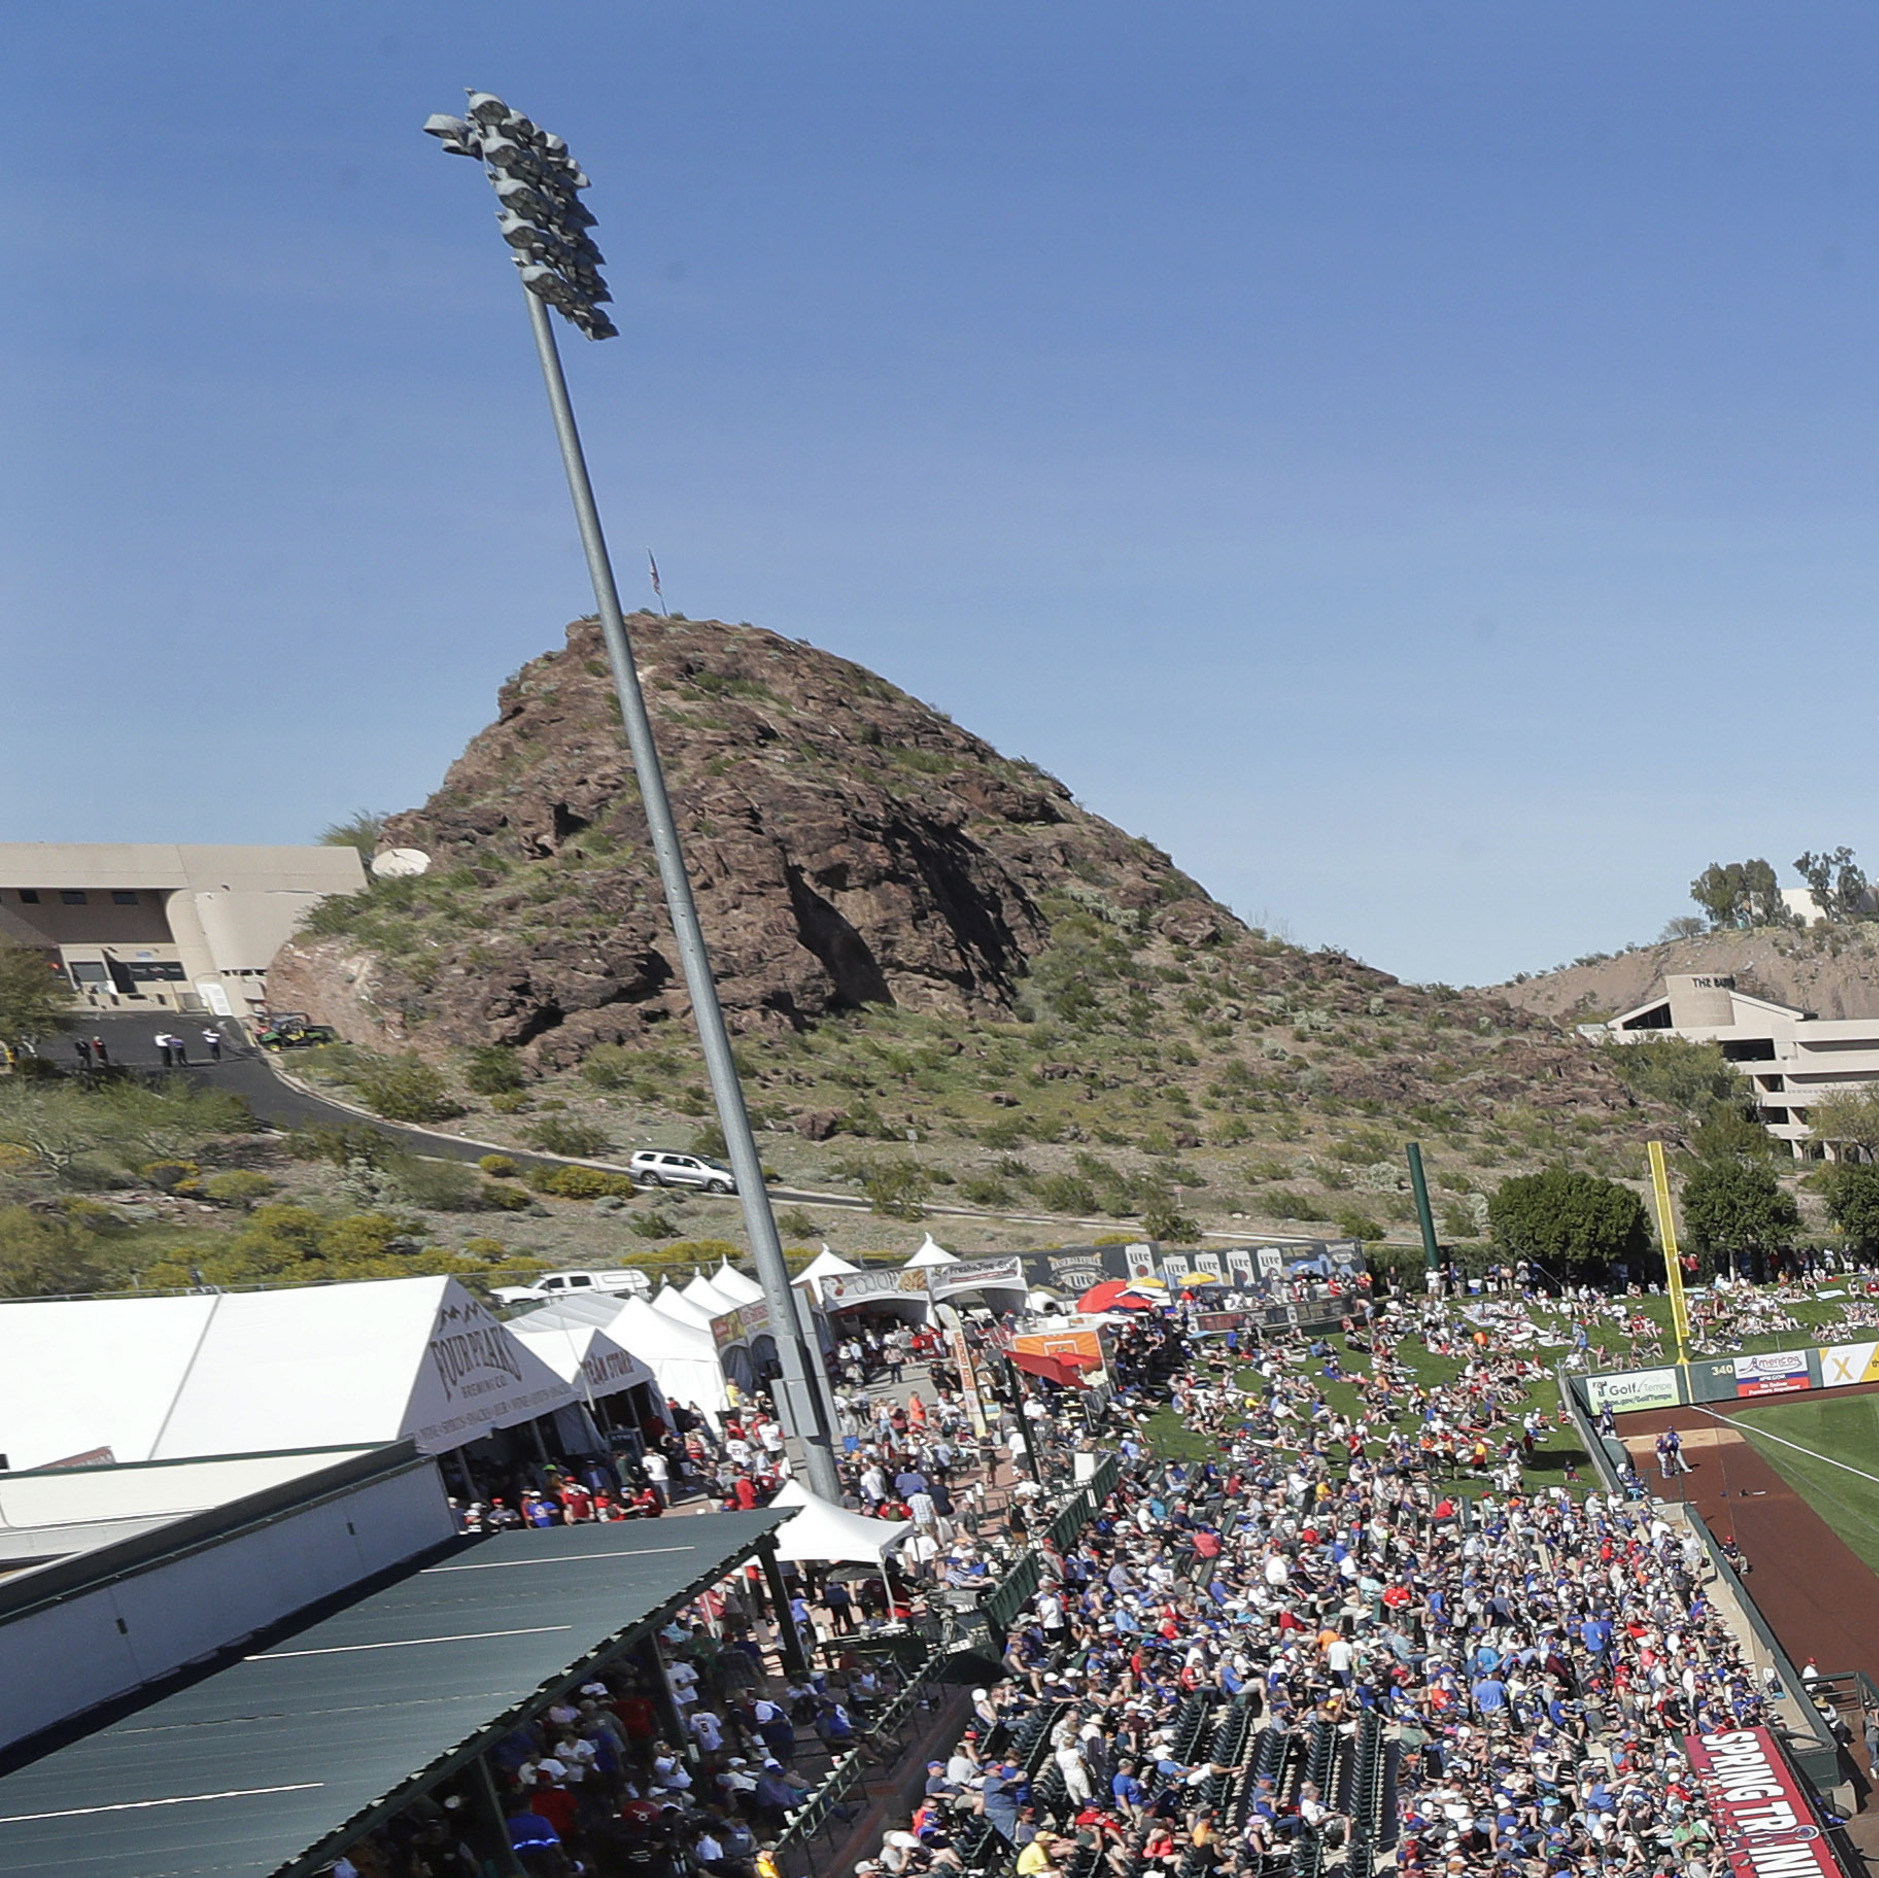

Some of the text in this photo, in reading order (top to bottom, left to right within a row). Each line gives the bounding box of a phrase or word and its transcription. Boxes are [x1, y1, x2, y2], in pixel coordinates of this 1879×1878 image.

[1129, 1252, 1150, 1264] Lite
[1230, 1257, 1251, 1269] Lite
[1260, 1254, 1281, 1267] Lite
[1711, 1364, 1733, 1376] 340
[1701, 1731, 1785, 1802] SPRING
